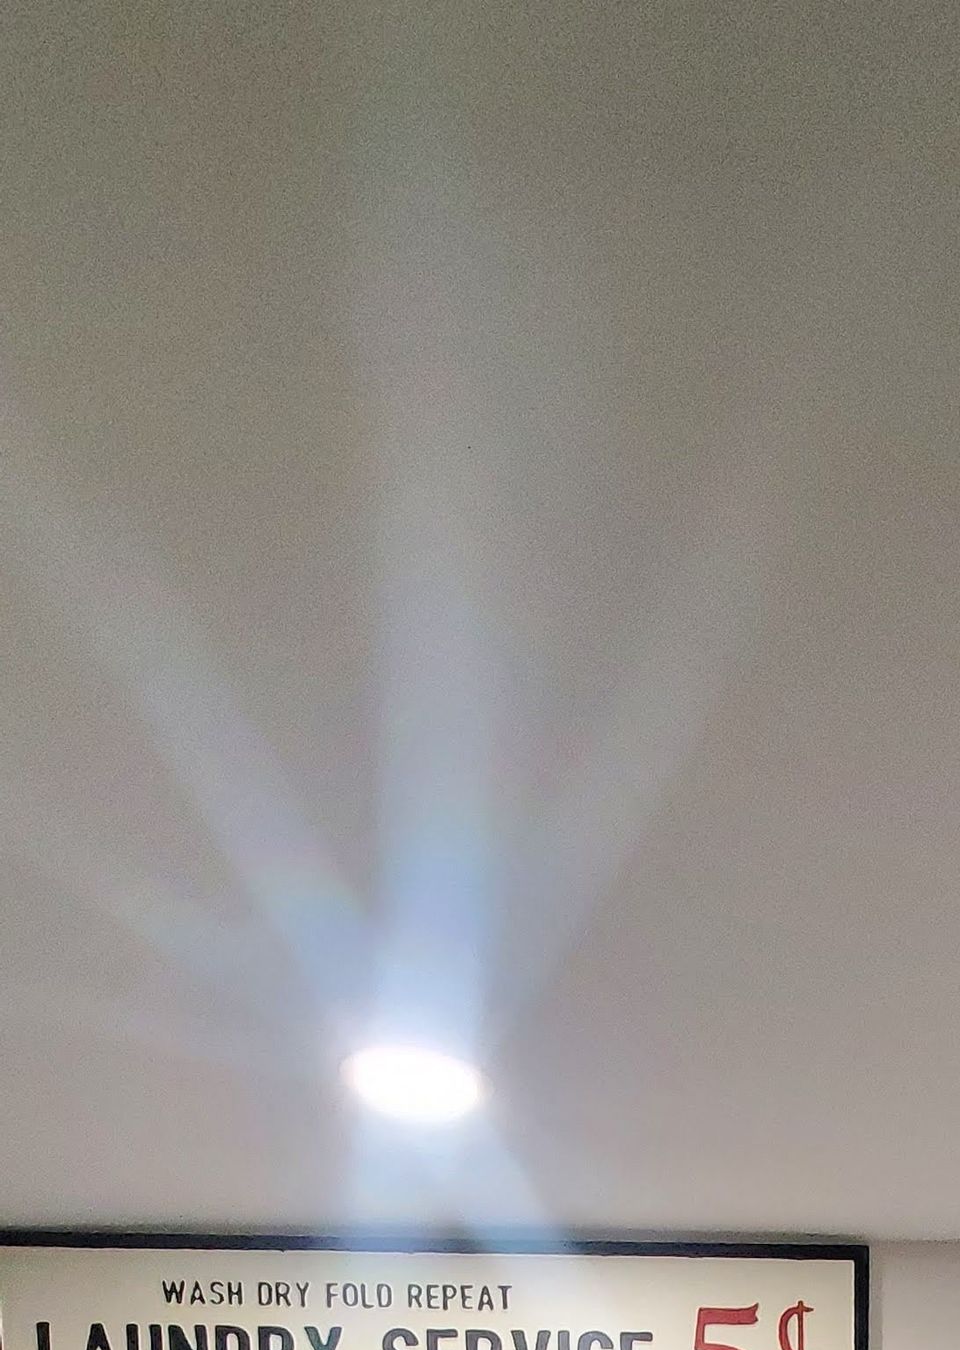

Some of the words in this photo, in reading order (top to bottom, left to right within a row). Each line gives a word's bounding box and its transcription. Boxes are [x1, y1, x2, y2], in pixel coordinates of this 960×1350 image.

[161, 1280, 243, 1306] WASH
[258, 1281, 309, 1308] DRY
[326, 1283, 393, 1309] FOLD
[408, 1284, 512, 1311] REPEAT
